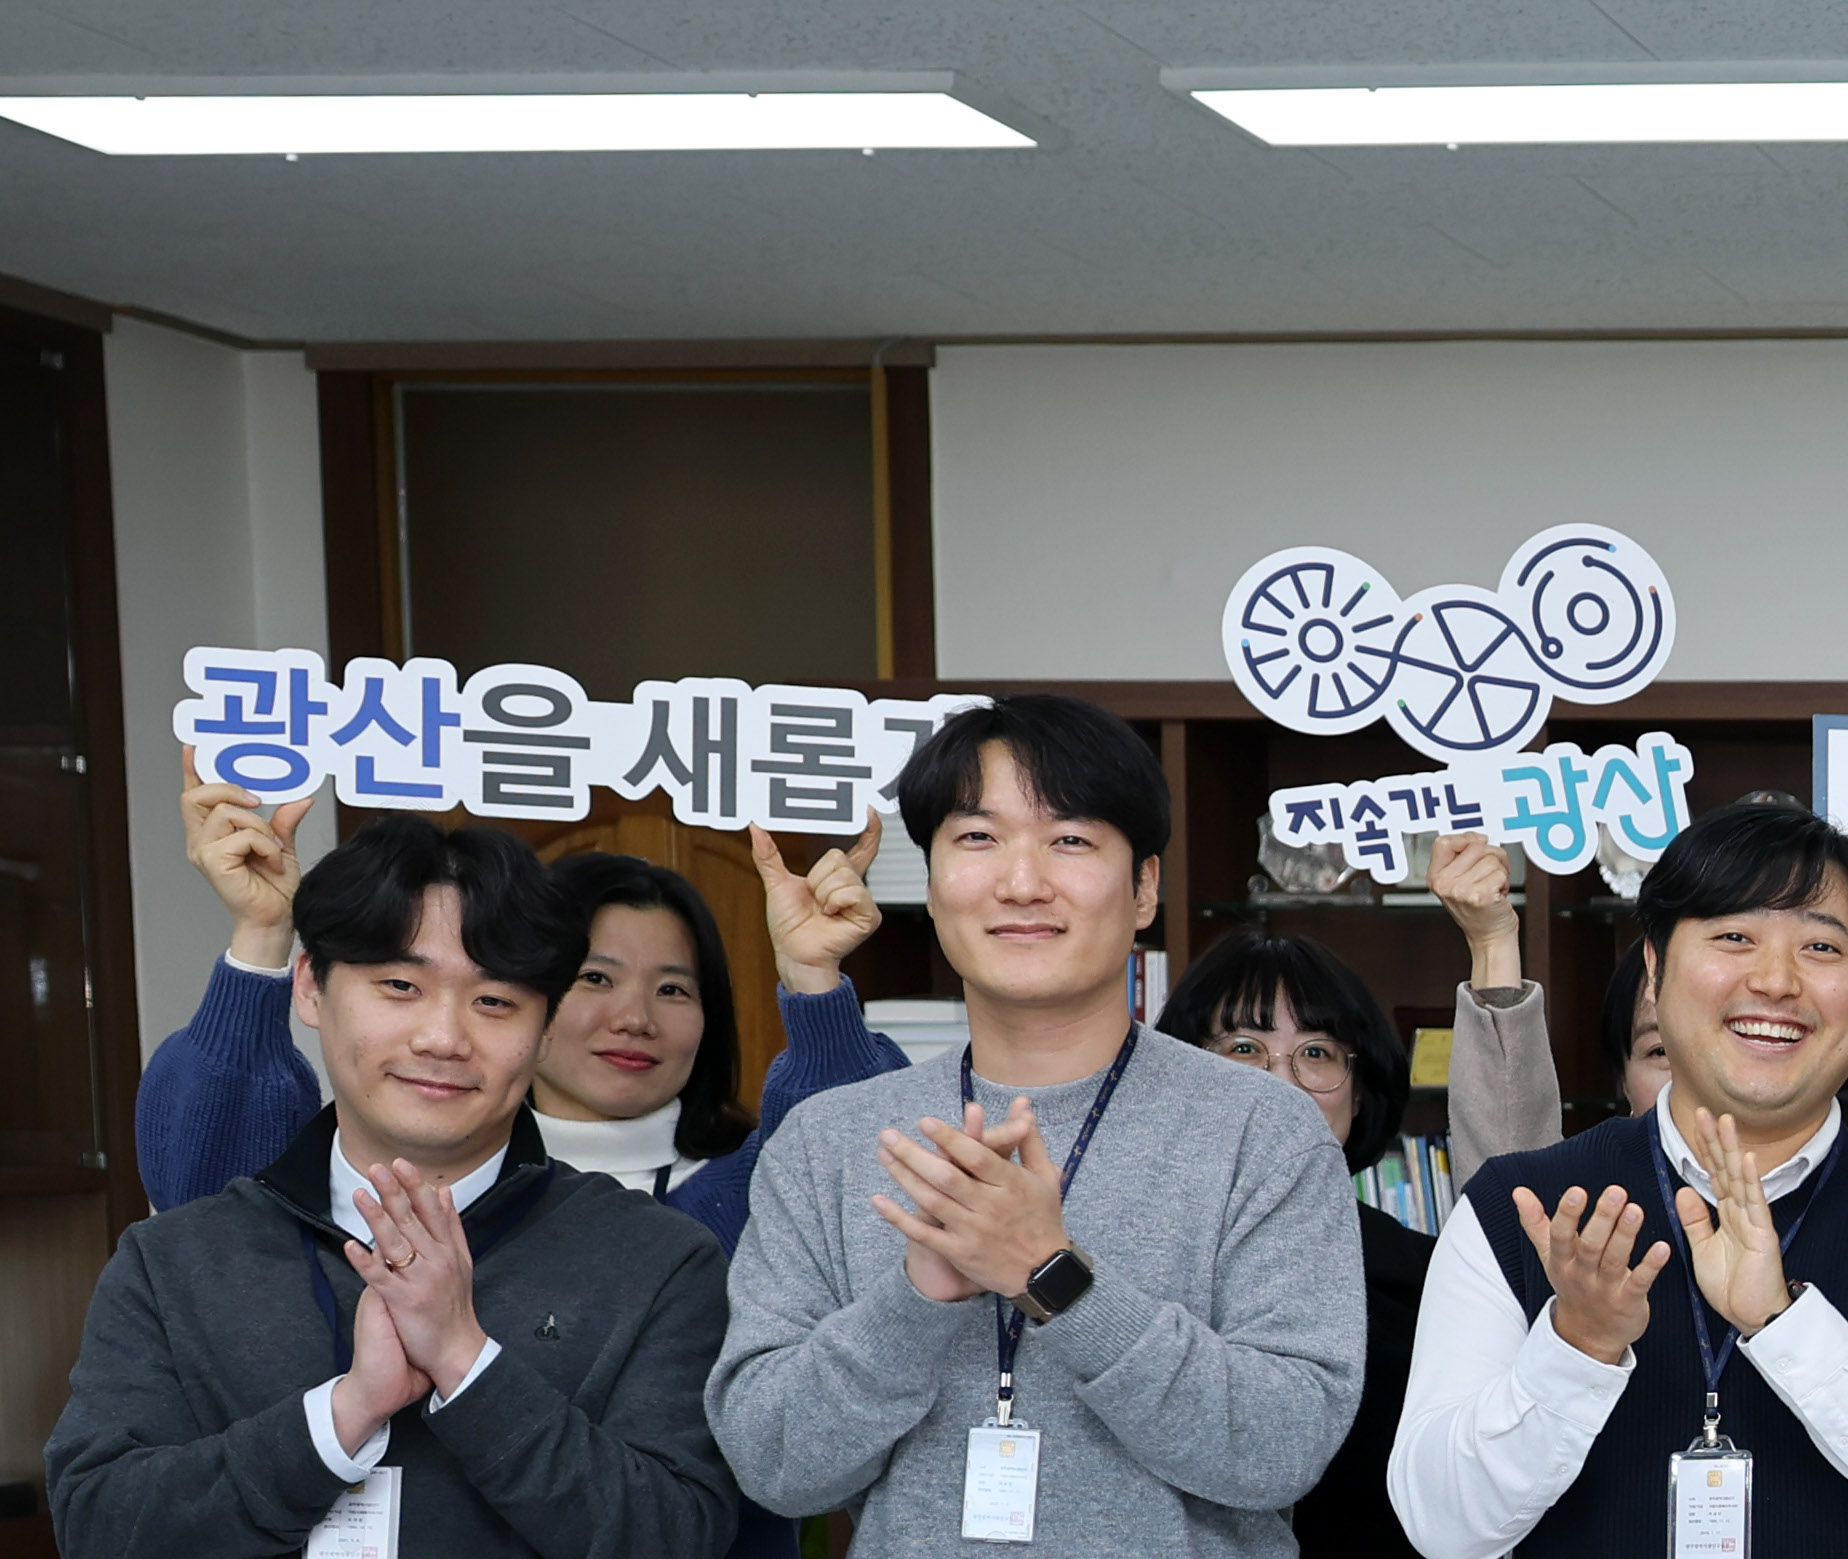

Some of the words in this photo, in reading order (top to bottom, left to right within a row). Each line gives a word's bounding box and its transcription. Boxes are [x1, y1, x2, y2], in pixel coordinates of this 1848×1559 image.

[194, 665, 591, 810] 광산을
[623, 696, 944, 824] 새롭
[1286, 783, 1483, 872] 지속가는
[1503, 745, 1682, 861] 광산
